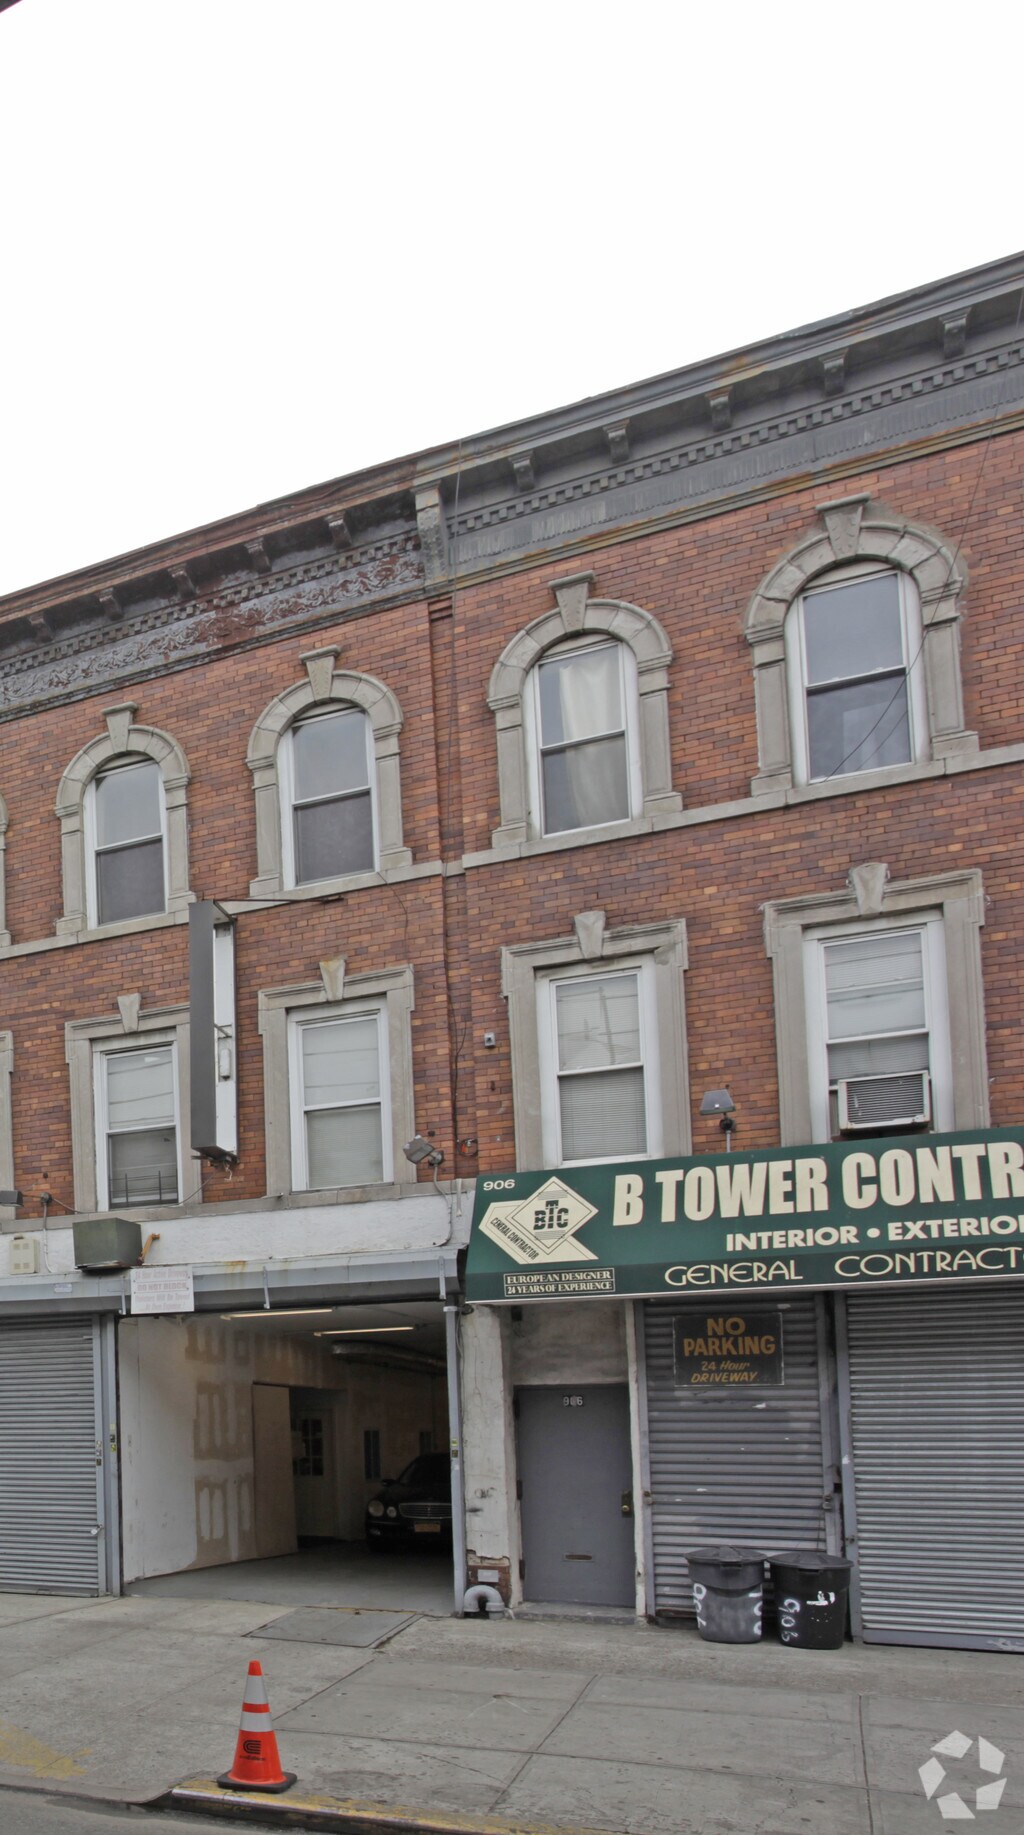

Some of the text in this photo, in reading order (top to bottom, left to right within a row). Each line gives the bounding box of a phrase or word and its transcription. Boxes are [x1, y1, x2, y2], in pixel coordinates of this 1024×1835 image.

[483, 1179, 515, 1191] 906
[612, 1141, 1024, 1227] B TOWER CONTR
[533, 1200, 569, 1230] BTC
[490, 1217, 539, 1260] GENERAL CONTRACTOR
[726, 1225, 860, 1252] INTERIOR
[507, 1270, 611, 1284] EUROPEAN DESIGNER
[664, 1247, 1024, 1286] GENERAL CONTRACT
[507, 1282, 612, 1294] 24 YEARS OF EXPERIENCE
[707, 1316, 746, 1336] NO
[683, 1335, 776, 1357] PARKING
[701, 1360, 750, 1371] 24 Hour
[691, 1371, 758, 1383] DRIVEWAY
